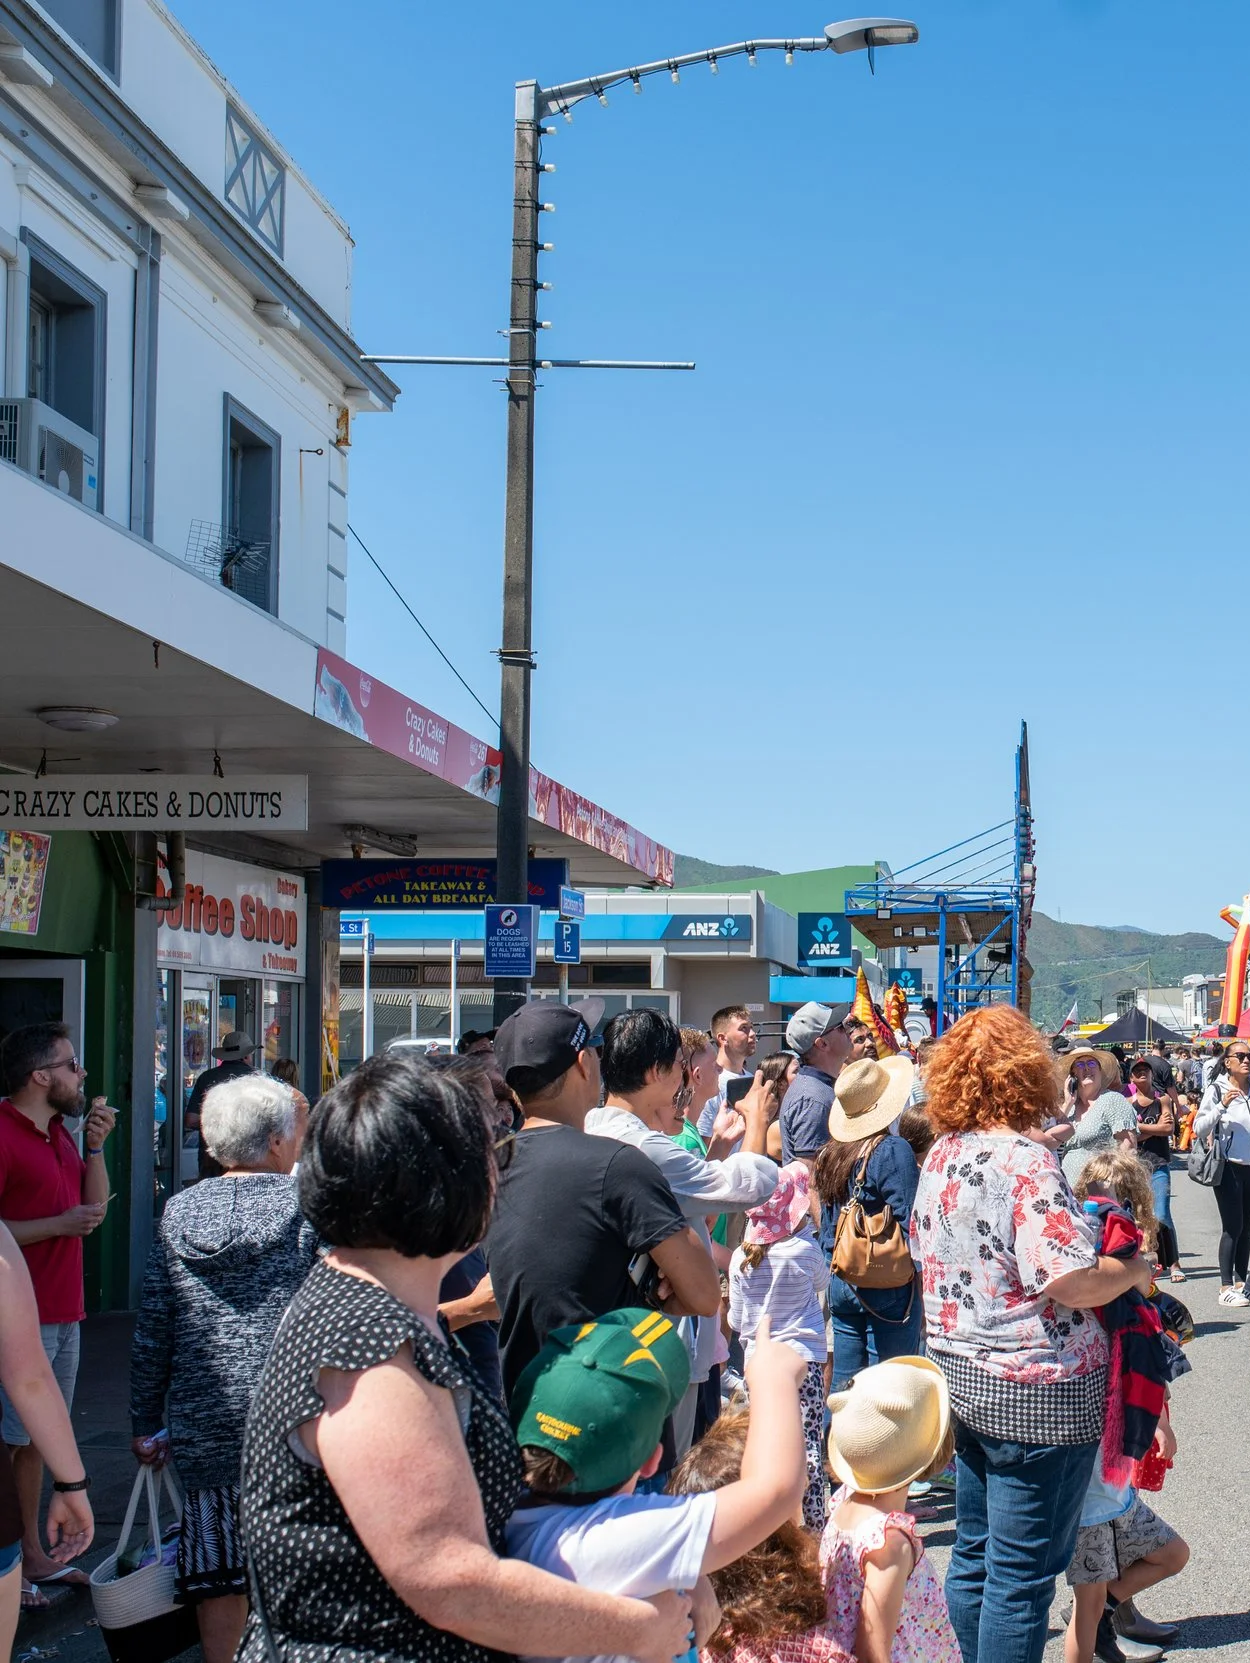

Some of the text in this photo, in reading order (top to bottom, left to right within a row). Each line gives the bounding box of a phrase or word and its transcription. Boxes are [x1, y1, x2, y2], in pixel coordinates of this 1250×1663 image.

[406, 707, 446, 745] Crazy Cakes
[409, 733, 415, 753] &
[415, 737, 439, 766] Donuts
[83, 790, 158, 818] CAKES
[166, 791, 181, 818] &
[188, 791, 282, 818] DONUTS
[340, 863, 491, 900] PETONE COFFEE
[404, 881, 486, 891] TAKEAWAY &
[373, 894, 496, 904] ALL DAY BREAKFA
[241, 894, 298, 951] Shop
[348, 923, 358, 933] St
[682, 922, 720, 936] ANZ
[496, 928, 521, 936] DOGS
[563, 924, 571, 939] P
[563, 941, 571, 953] 15
[808, 943, 840, 955] ANZ
[902, 987, 916, 995] NZ
